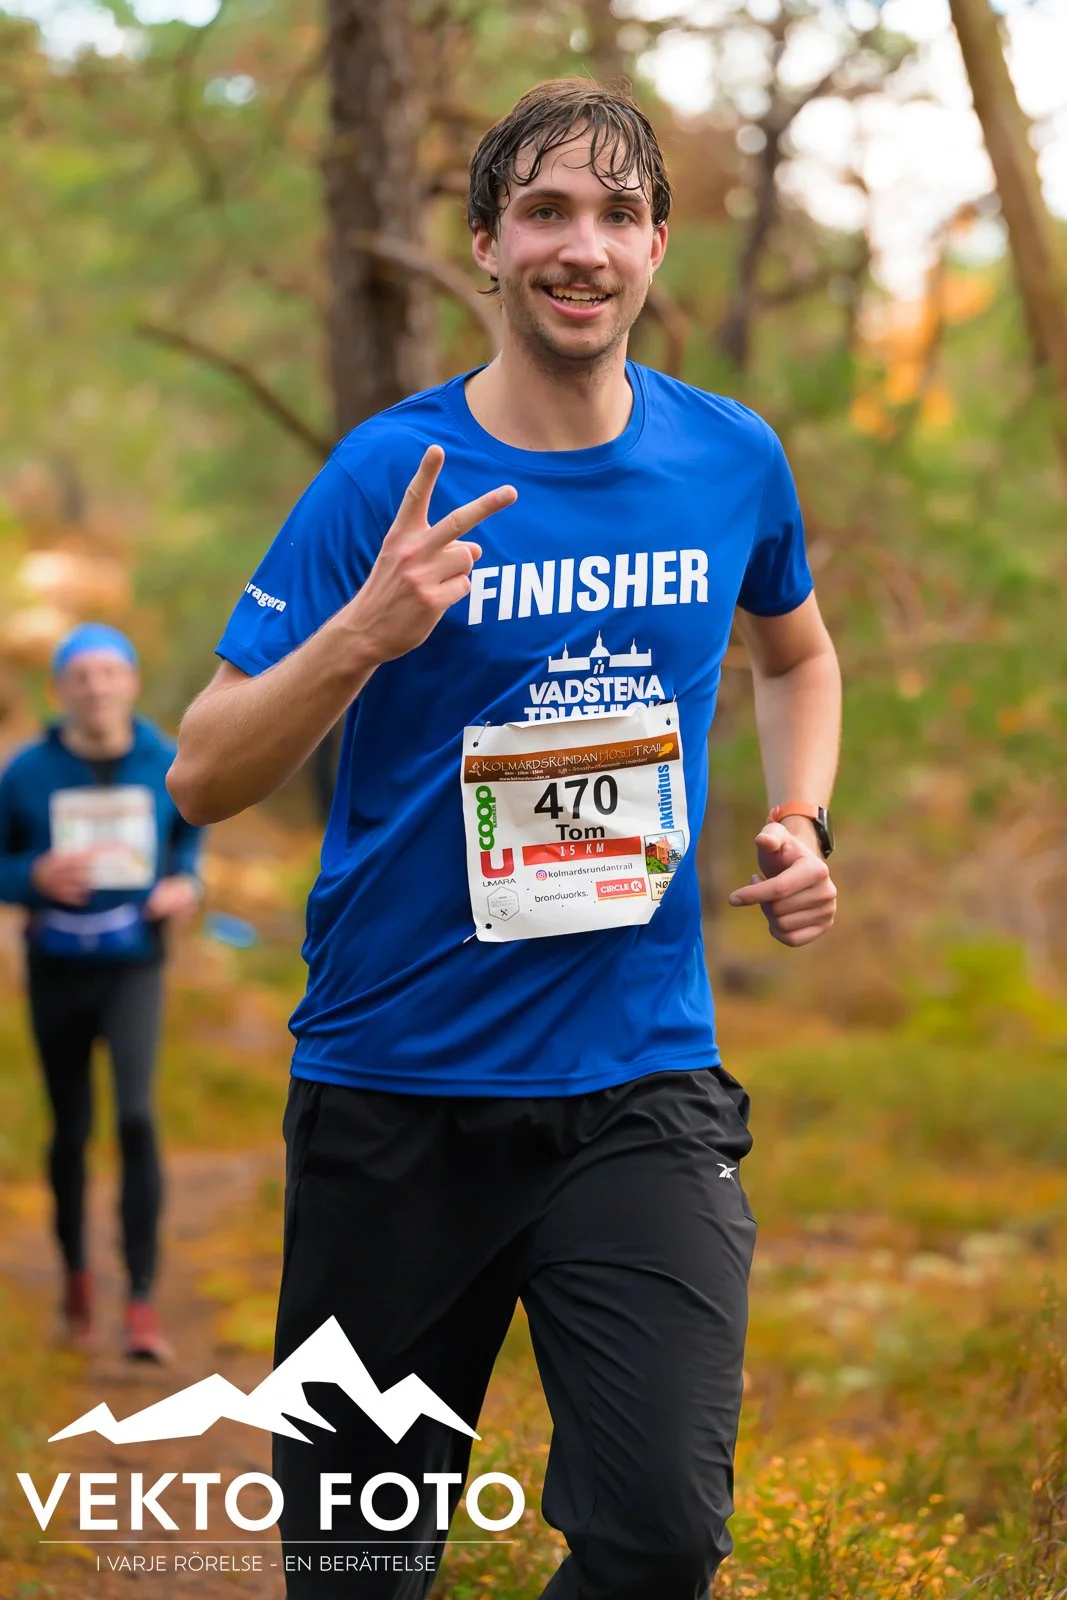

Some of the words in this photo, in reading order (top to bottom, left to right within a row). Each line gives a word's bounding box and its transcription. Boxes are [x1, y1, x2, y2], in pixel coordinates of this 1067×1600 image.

[244, 581, 287, 612] ragera
[468, 548, 709, 626] FINISHER
[528, 674, 666, 705] VADSTENA
[534, 774, 618, 820] 470
[658, 764, 675, 830] Aktivitus
[475, 785, 496, 851] coop
[556, 824, 605, 841] Tom
[559, 844, 576, 857] 15
[586, 842, 605, 854] KM
[482, 878, 517, 888] UMARA
[548, 863, 633, 879] kolmardsrundantrail
[600, 883, 630, 894] CIRCLE
